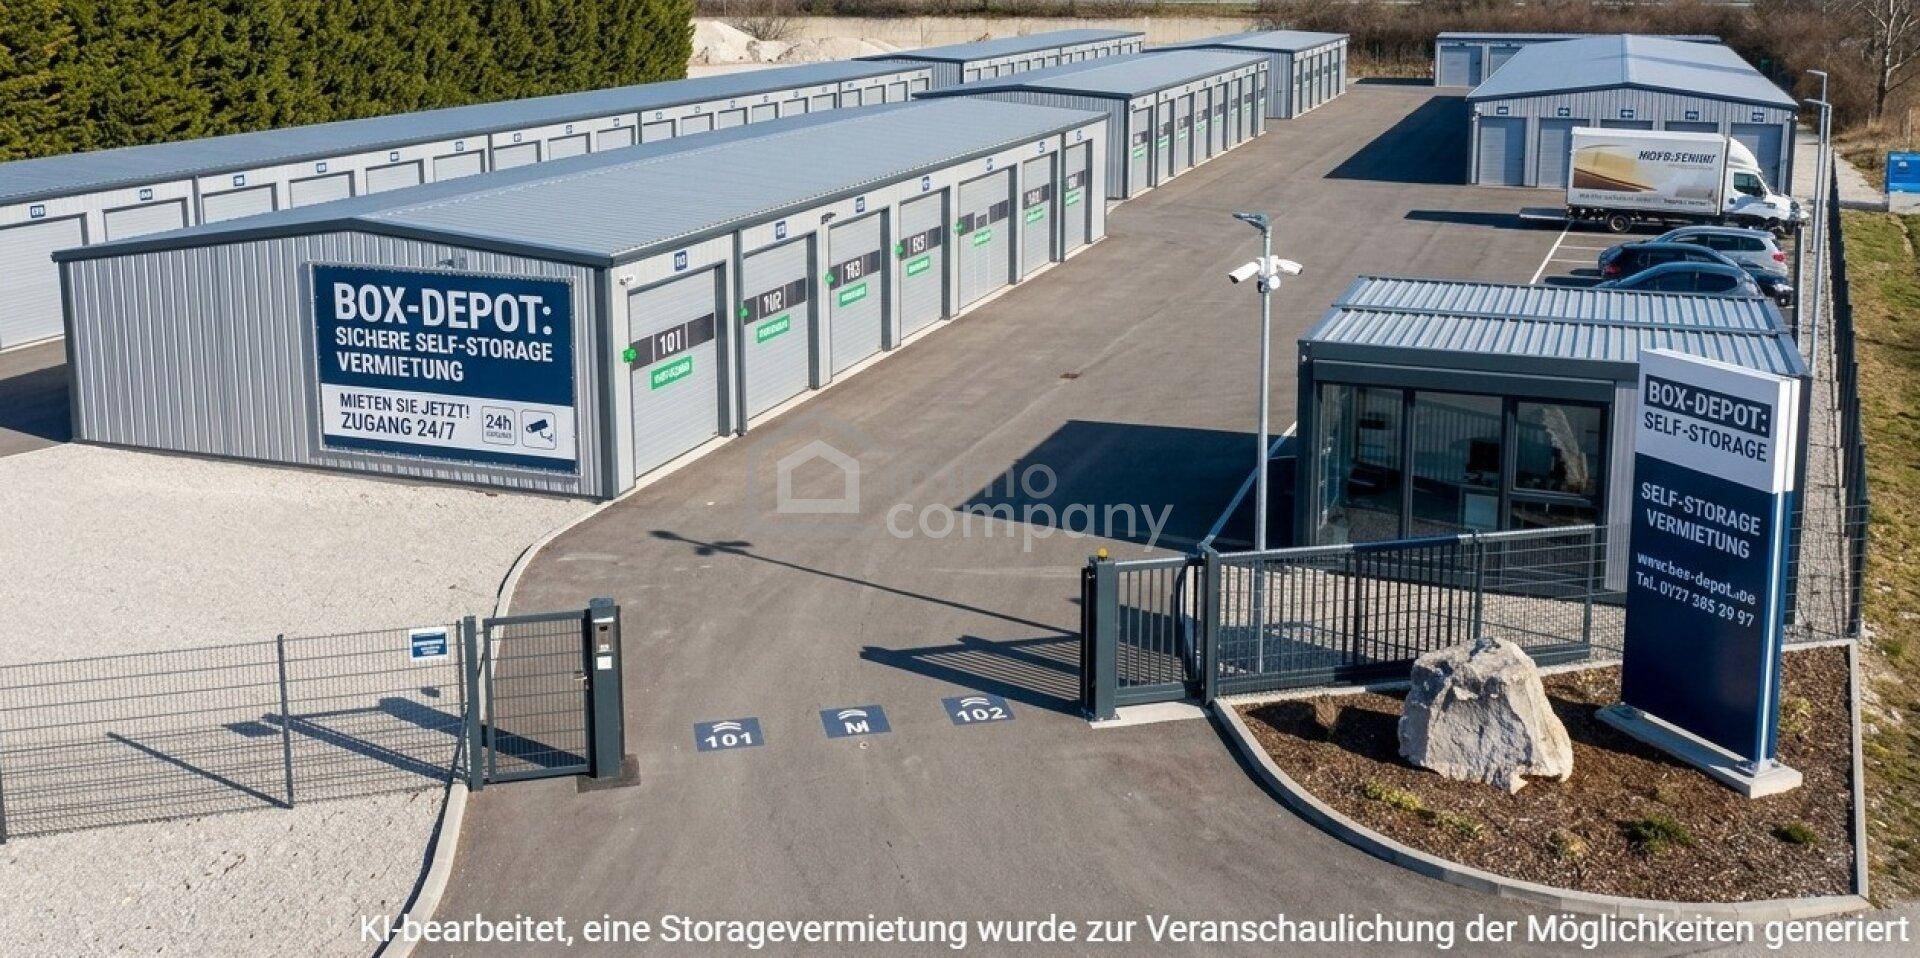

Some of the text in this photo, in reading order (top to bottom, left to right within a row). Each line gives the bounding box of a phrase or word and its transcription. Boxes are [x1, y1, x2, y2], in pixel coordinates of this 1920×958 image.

[333, 281, 553, 335] BOX-DEPOT:
[335, 326, 553, 363] SICHERE SELF-STORAGE
[659, 329, 681, 355] 101
[336, 351, 464, 382] VERMIETUNG
[339, 393, 471, 419] MIETEN SIE JETZT!
[485, 414, 512, 431] 24h
[1648, 380, 1768, 434] BOX-DEPOT:
[341, 411, 456, 440] ZUGANG 24/7
[1643, 411, 1767, 463] SELF-STORAGE
[1641, 481, 1762, 537] SELF-STORAGE
[1647, 508, 1751, 559] VERMIETUNG
[1692, 593, 1715, 614] 385
[1718, 603, 1735, 620] 29
[1738, 610, 1755, 628] 97
[956, 707, 1008, 723] 102
[704, 731, 754, 748] 101
